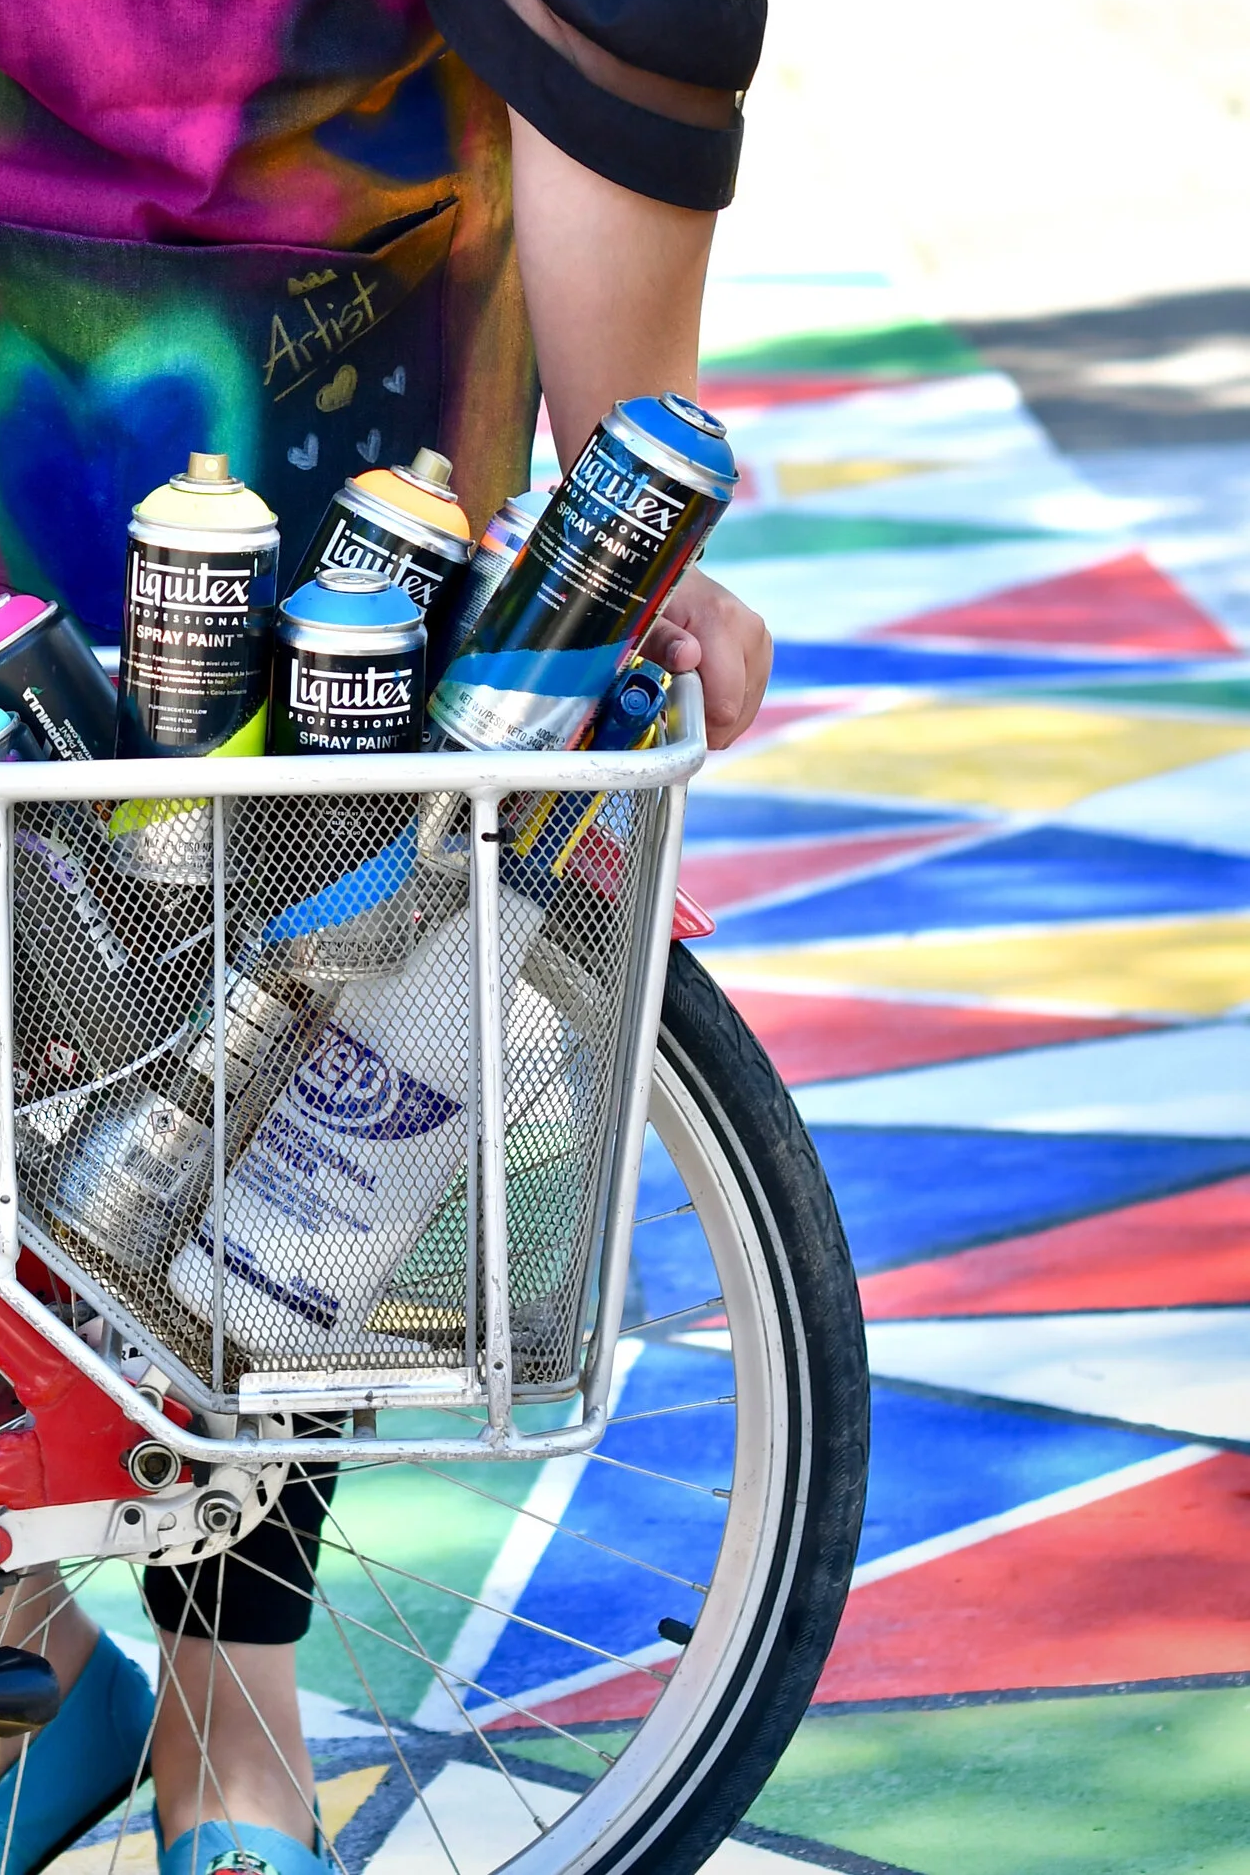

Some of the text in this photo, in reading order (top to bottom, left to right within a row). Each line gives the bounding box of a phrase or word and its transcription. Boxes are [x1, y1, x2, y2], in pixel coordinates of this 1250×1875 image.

[263, 272, 378, 386] Artist
[570, 434, 686, 541] Liquitex
[556, 501, 595, 536] SPRAY
[563, 480, 660, 553] PROFESSIONAL
[130, 551, 251, 613] Liquitex
[320, 518, 444, 605] Liquitex
[129, 603, 249, 628] PROFESSIONAL
[136, 625, 183, 646] SPRAY
[148, 703, 184, 714] FLUORESCENT
[289, 658, 413, 716] Liquitex
[288, 712, 410, 729] PROFESSIONAL
[299, 731, 352, 750] SPRAY
[458, 690, 472, 707] NET
[505, 725, 526, 742] NETO
[269, 1111, 375, 1193] PROFESSIONAL
